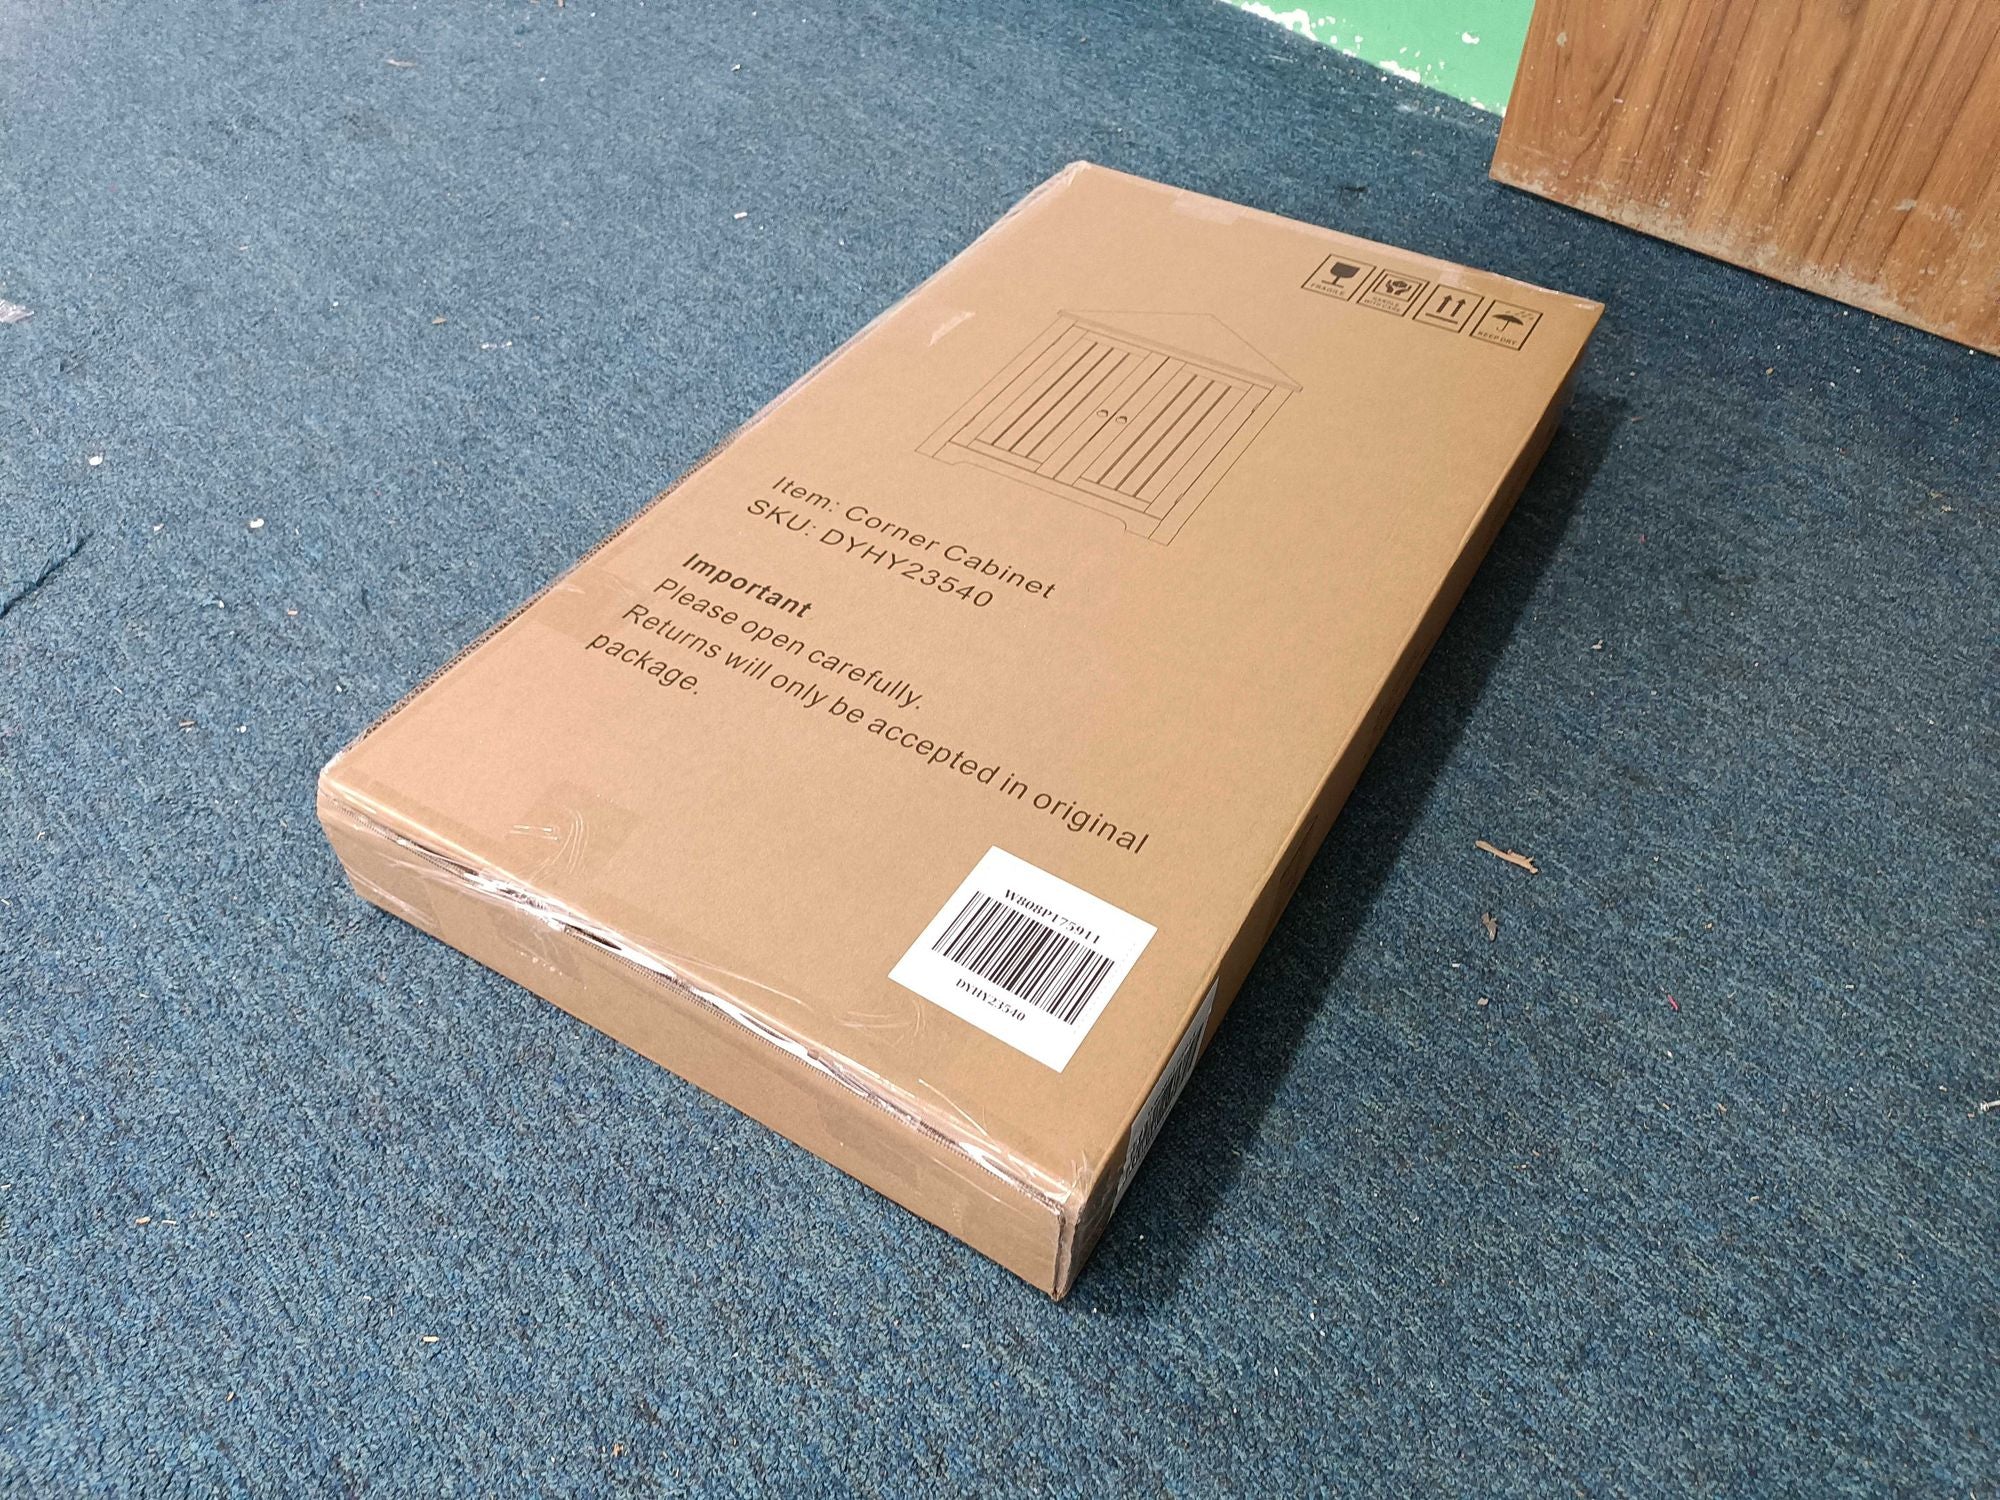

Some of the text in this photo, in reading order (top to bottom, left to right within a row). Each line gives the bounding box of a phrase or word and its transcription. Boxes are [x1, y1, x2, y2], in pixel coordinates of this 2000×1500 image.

[1310, 282, 1346, 296] FRAGILE
[1477, 331, 1518, 347] KEEP DRY
[746, 499, 994, 609] SKU: DYHY23540
[771, 476, 1056, 600] Item: Corner Cabinet
[682, 552, 813, 619] Important
[585, 632, 700, 695] package.
[653, 577, 922, 711] Please open carefully.
[622, 603, 1149, 855] Returns will only be accepted in original
